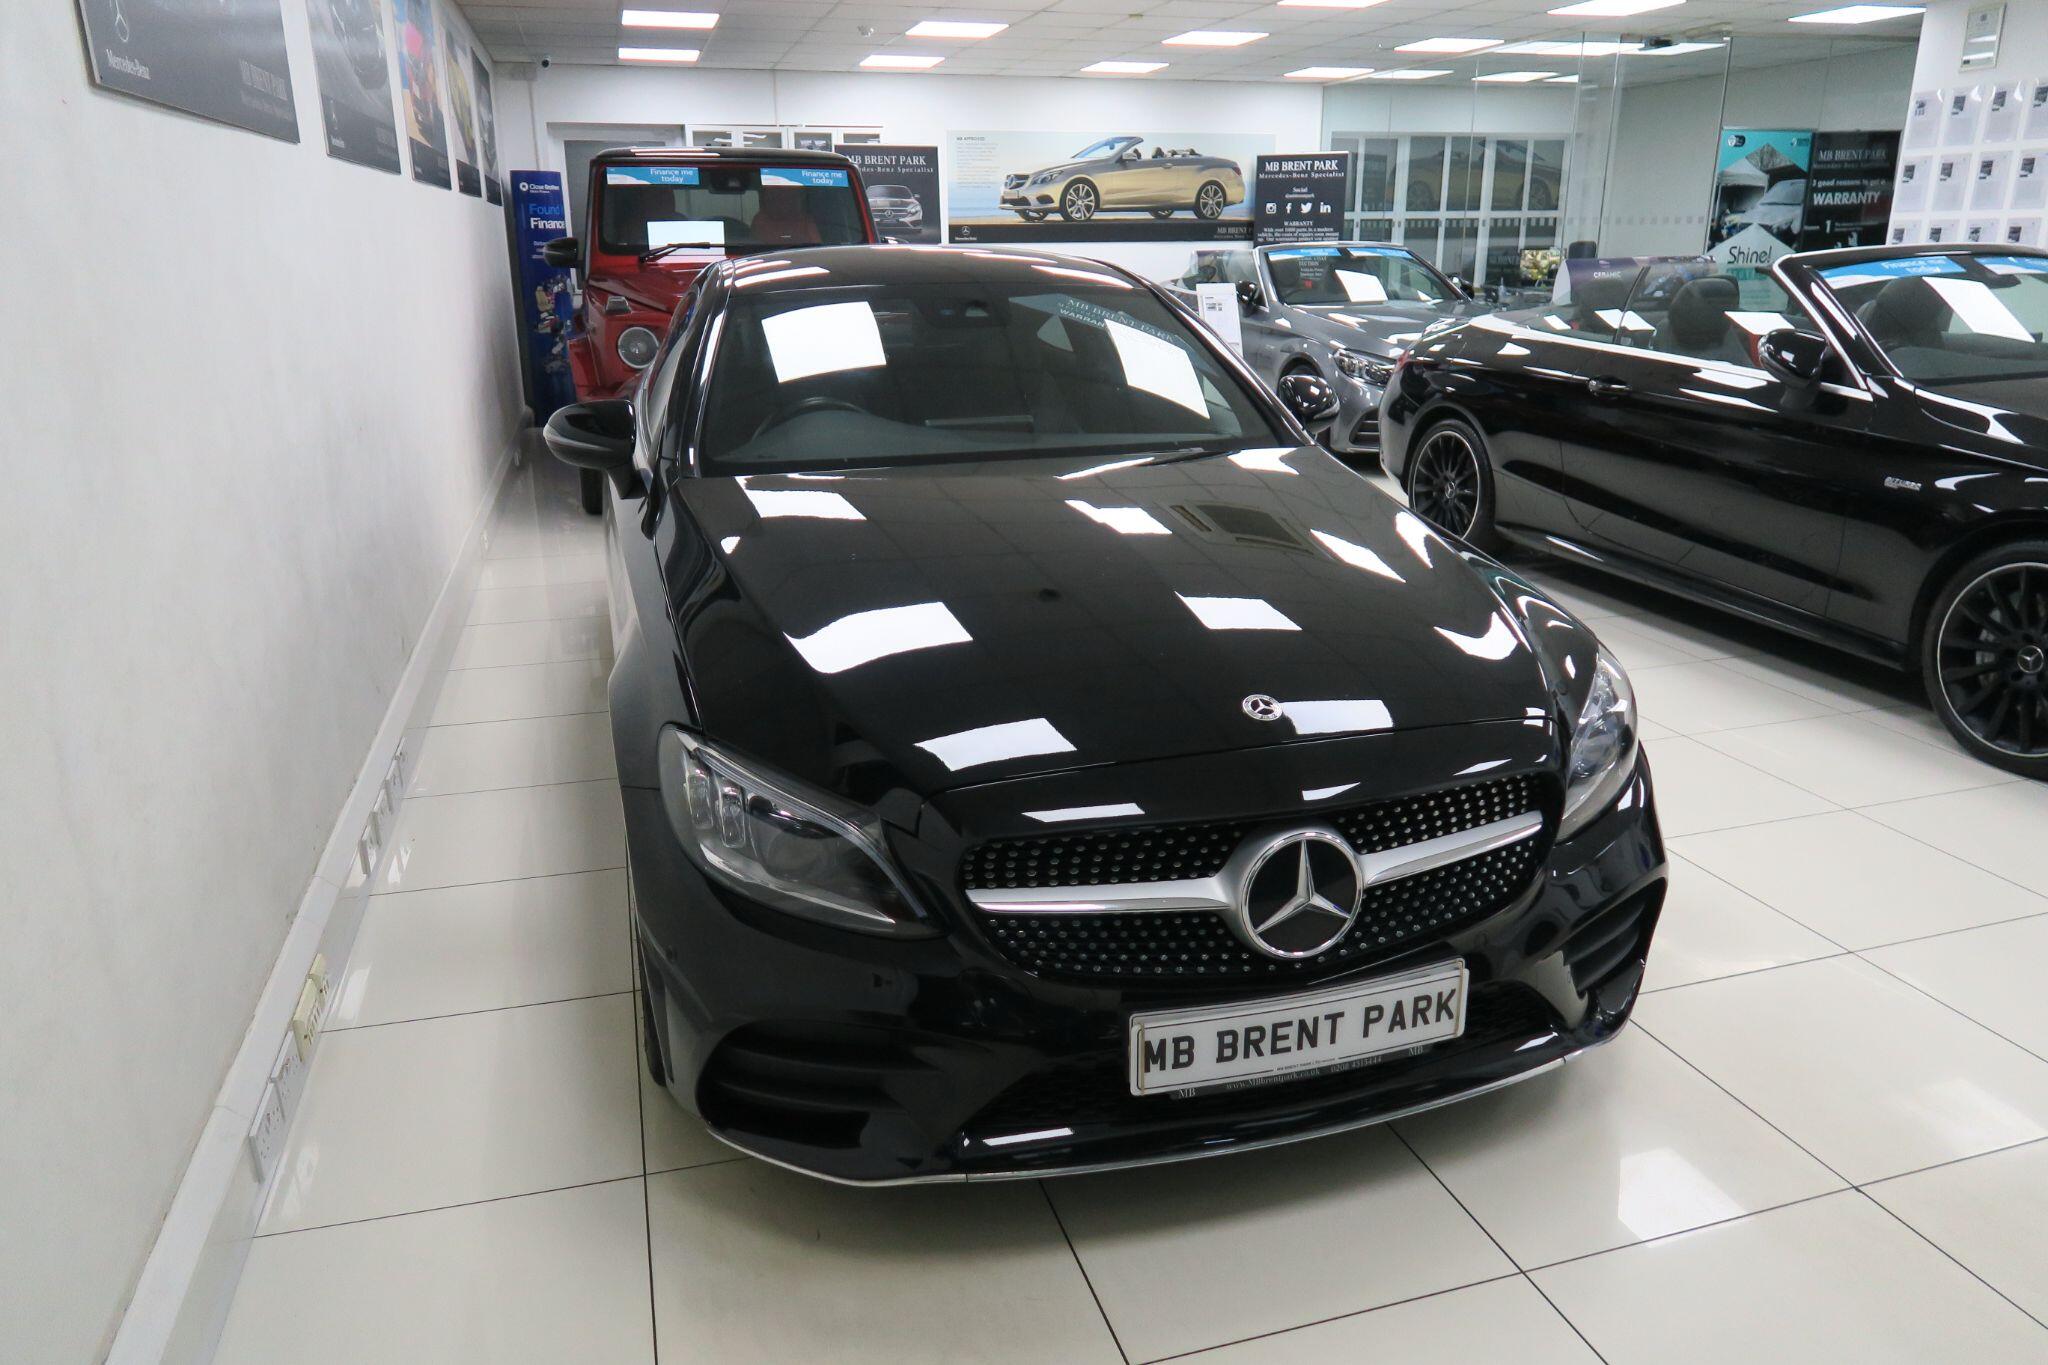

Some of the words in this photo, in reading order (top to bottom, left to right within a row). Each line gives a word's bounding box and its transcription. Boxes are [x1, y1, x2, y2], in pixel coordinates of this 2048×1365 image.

[865, 155, 897, 165] BRENT
[900, 155, 926, 165] PARK
[898, 166, 934, 174] Specialist
[1265, 161, 1280, 172] MB
[1281, 160, 1312, 171] BRENT
[1314, 160, 1338, 170] PARK
[650, 168, 679, 176] Finance
[802, 170, 830, 178] Finance
[1311, 171, 1344, 179] Specialist
[661, 175, 684, 183] today
[812, 177, 834, 185] today
[1813, 191, 1880, 206] WARRANTY
[529, 203, 560, 215] Found
[1727, 244, 1773, 265] Shine!
[1593, 271, 1621, 279] CERAMIC
[1060, 308, 1105, 328] WARRAN
[1144, 1035, 1195, 1073] MB
[1216, 1011, 1345, 1063] BRENT
[1363, 988, 1456, 1038] PARK
[1408, 1045, 1424, 1057] MB
[1179, 1087, 1196, 1099] MB
